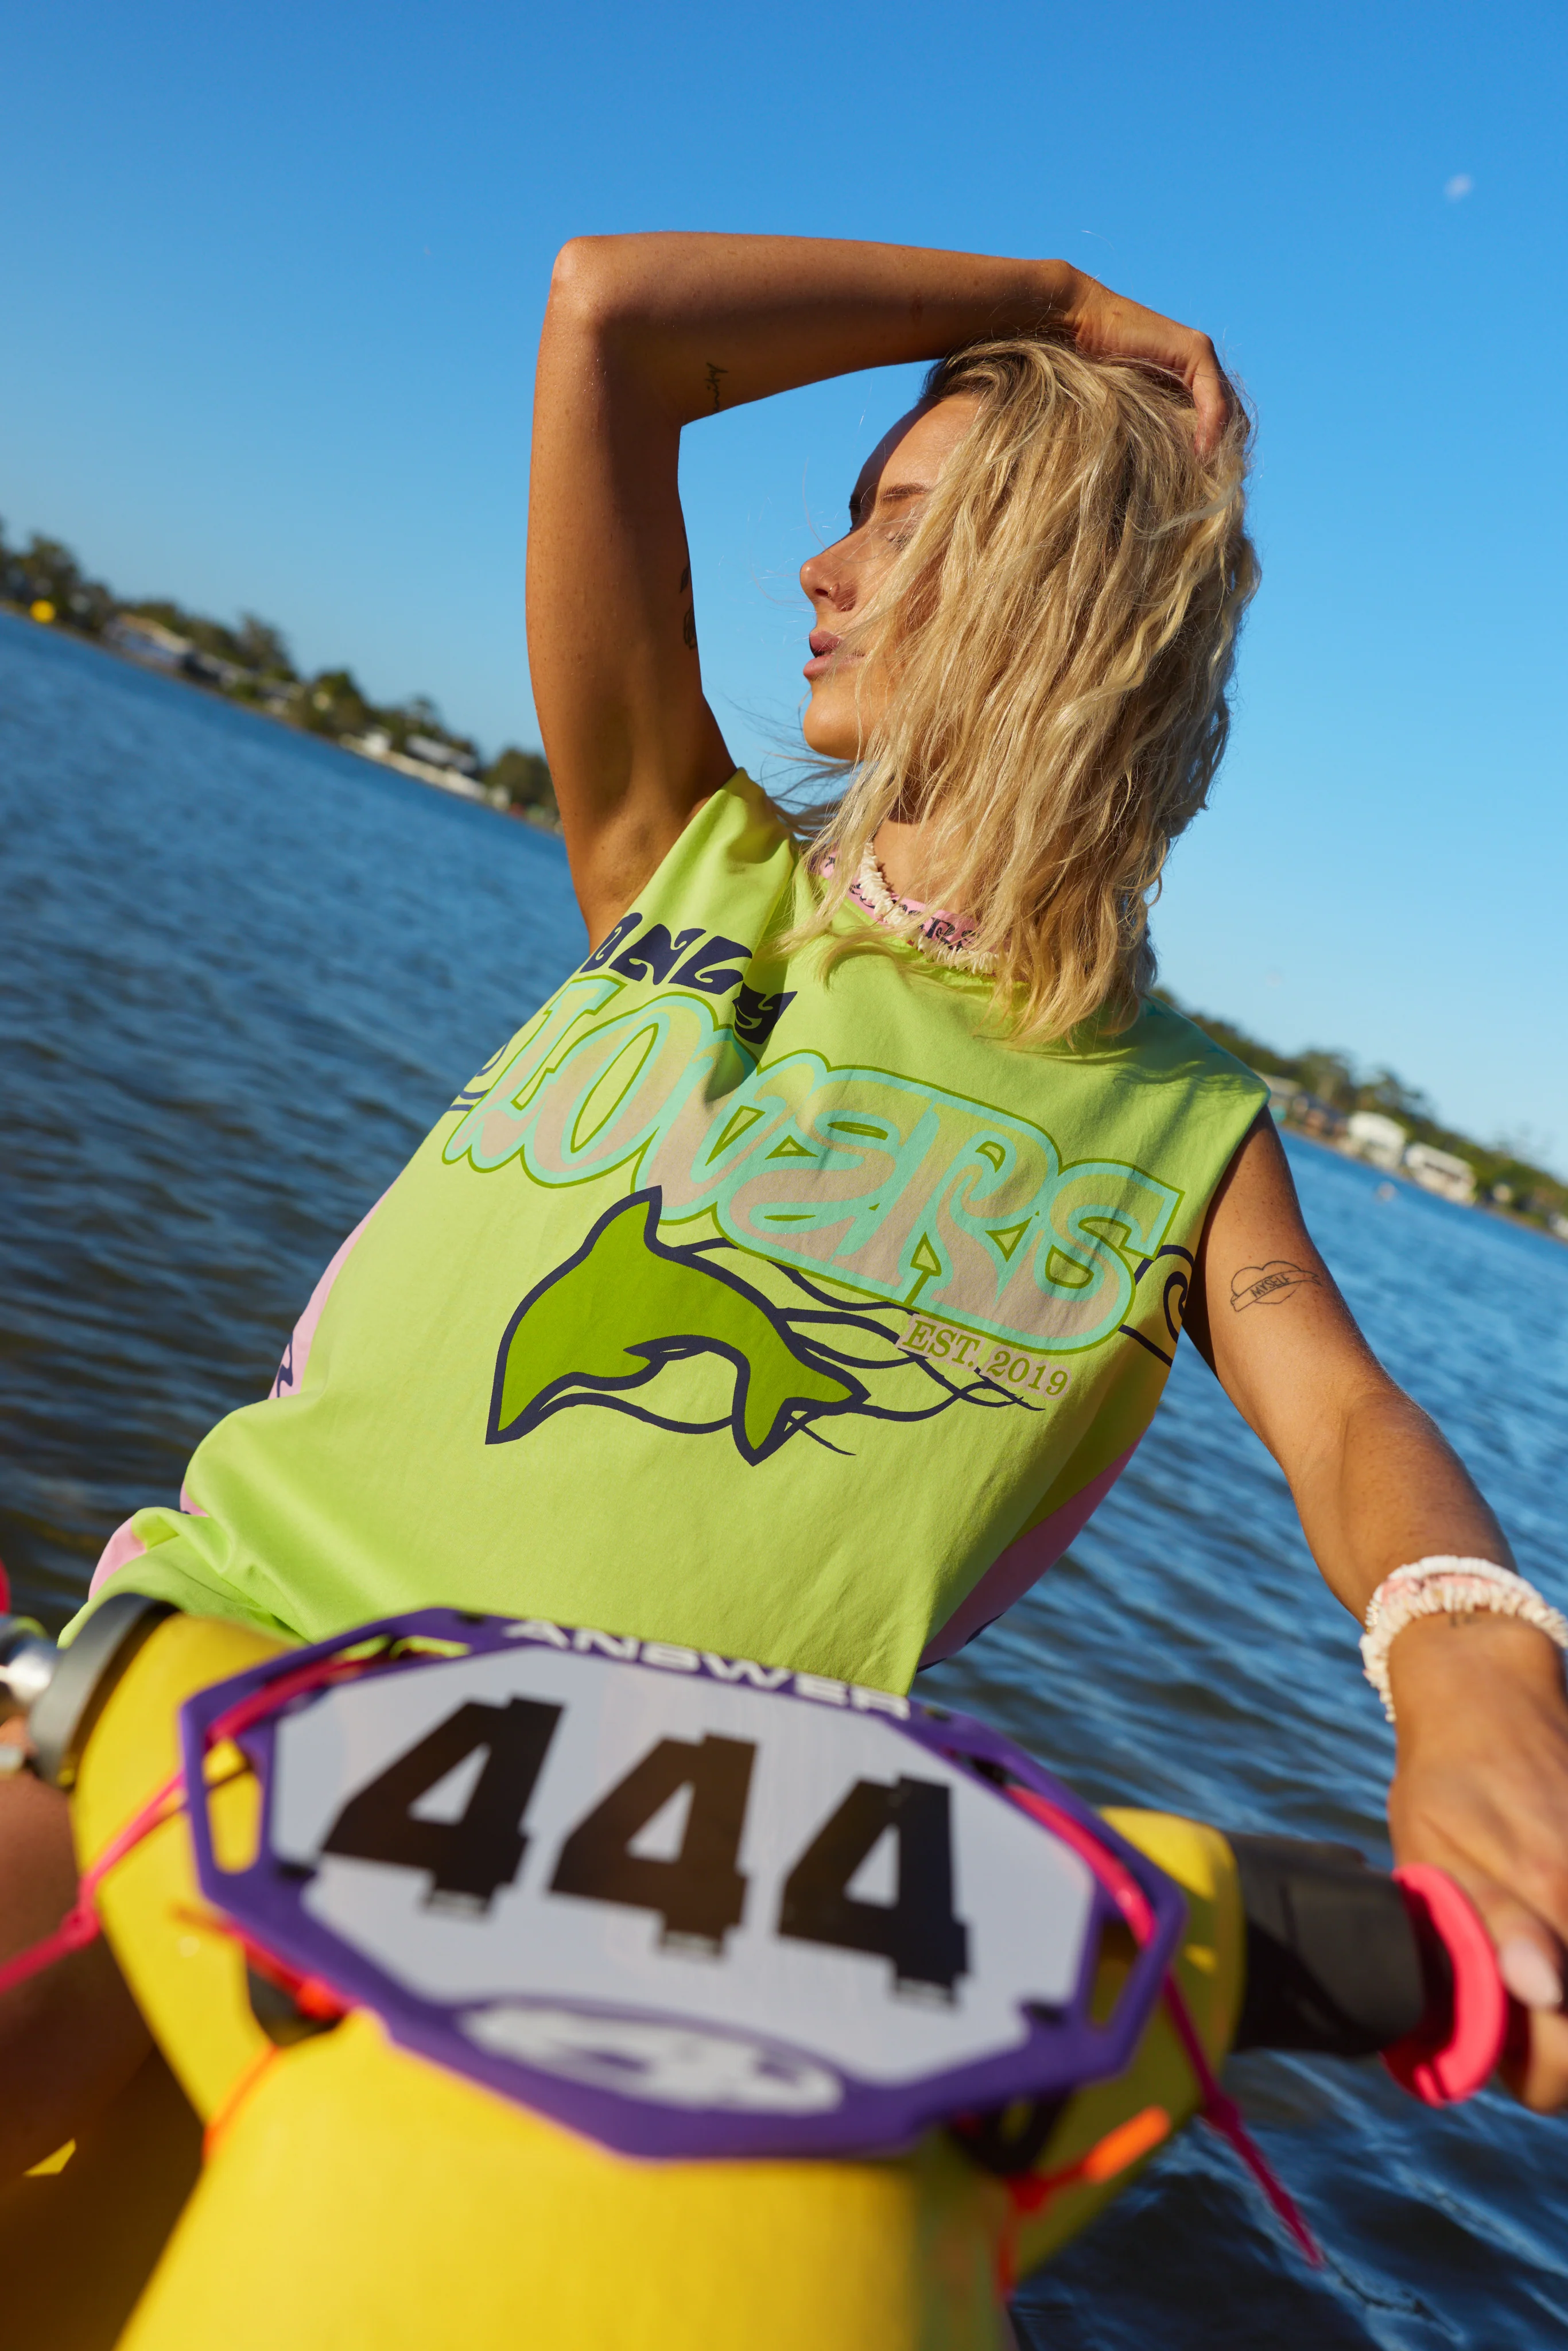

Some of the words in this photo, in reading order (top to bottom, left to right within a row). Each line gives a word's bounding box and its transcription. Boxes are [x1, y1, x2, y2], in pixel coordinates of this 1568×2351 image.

[1249, 1274, 1290, 1298] MYSELF
[902, 1320, 981, 1368] EST.
[987, 1351, 1068, 1396] 2019
[502, 1619, 910, 1720] ANSWER
[321, 1694, 971, 2008] 444
